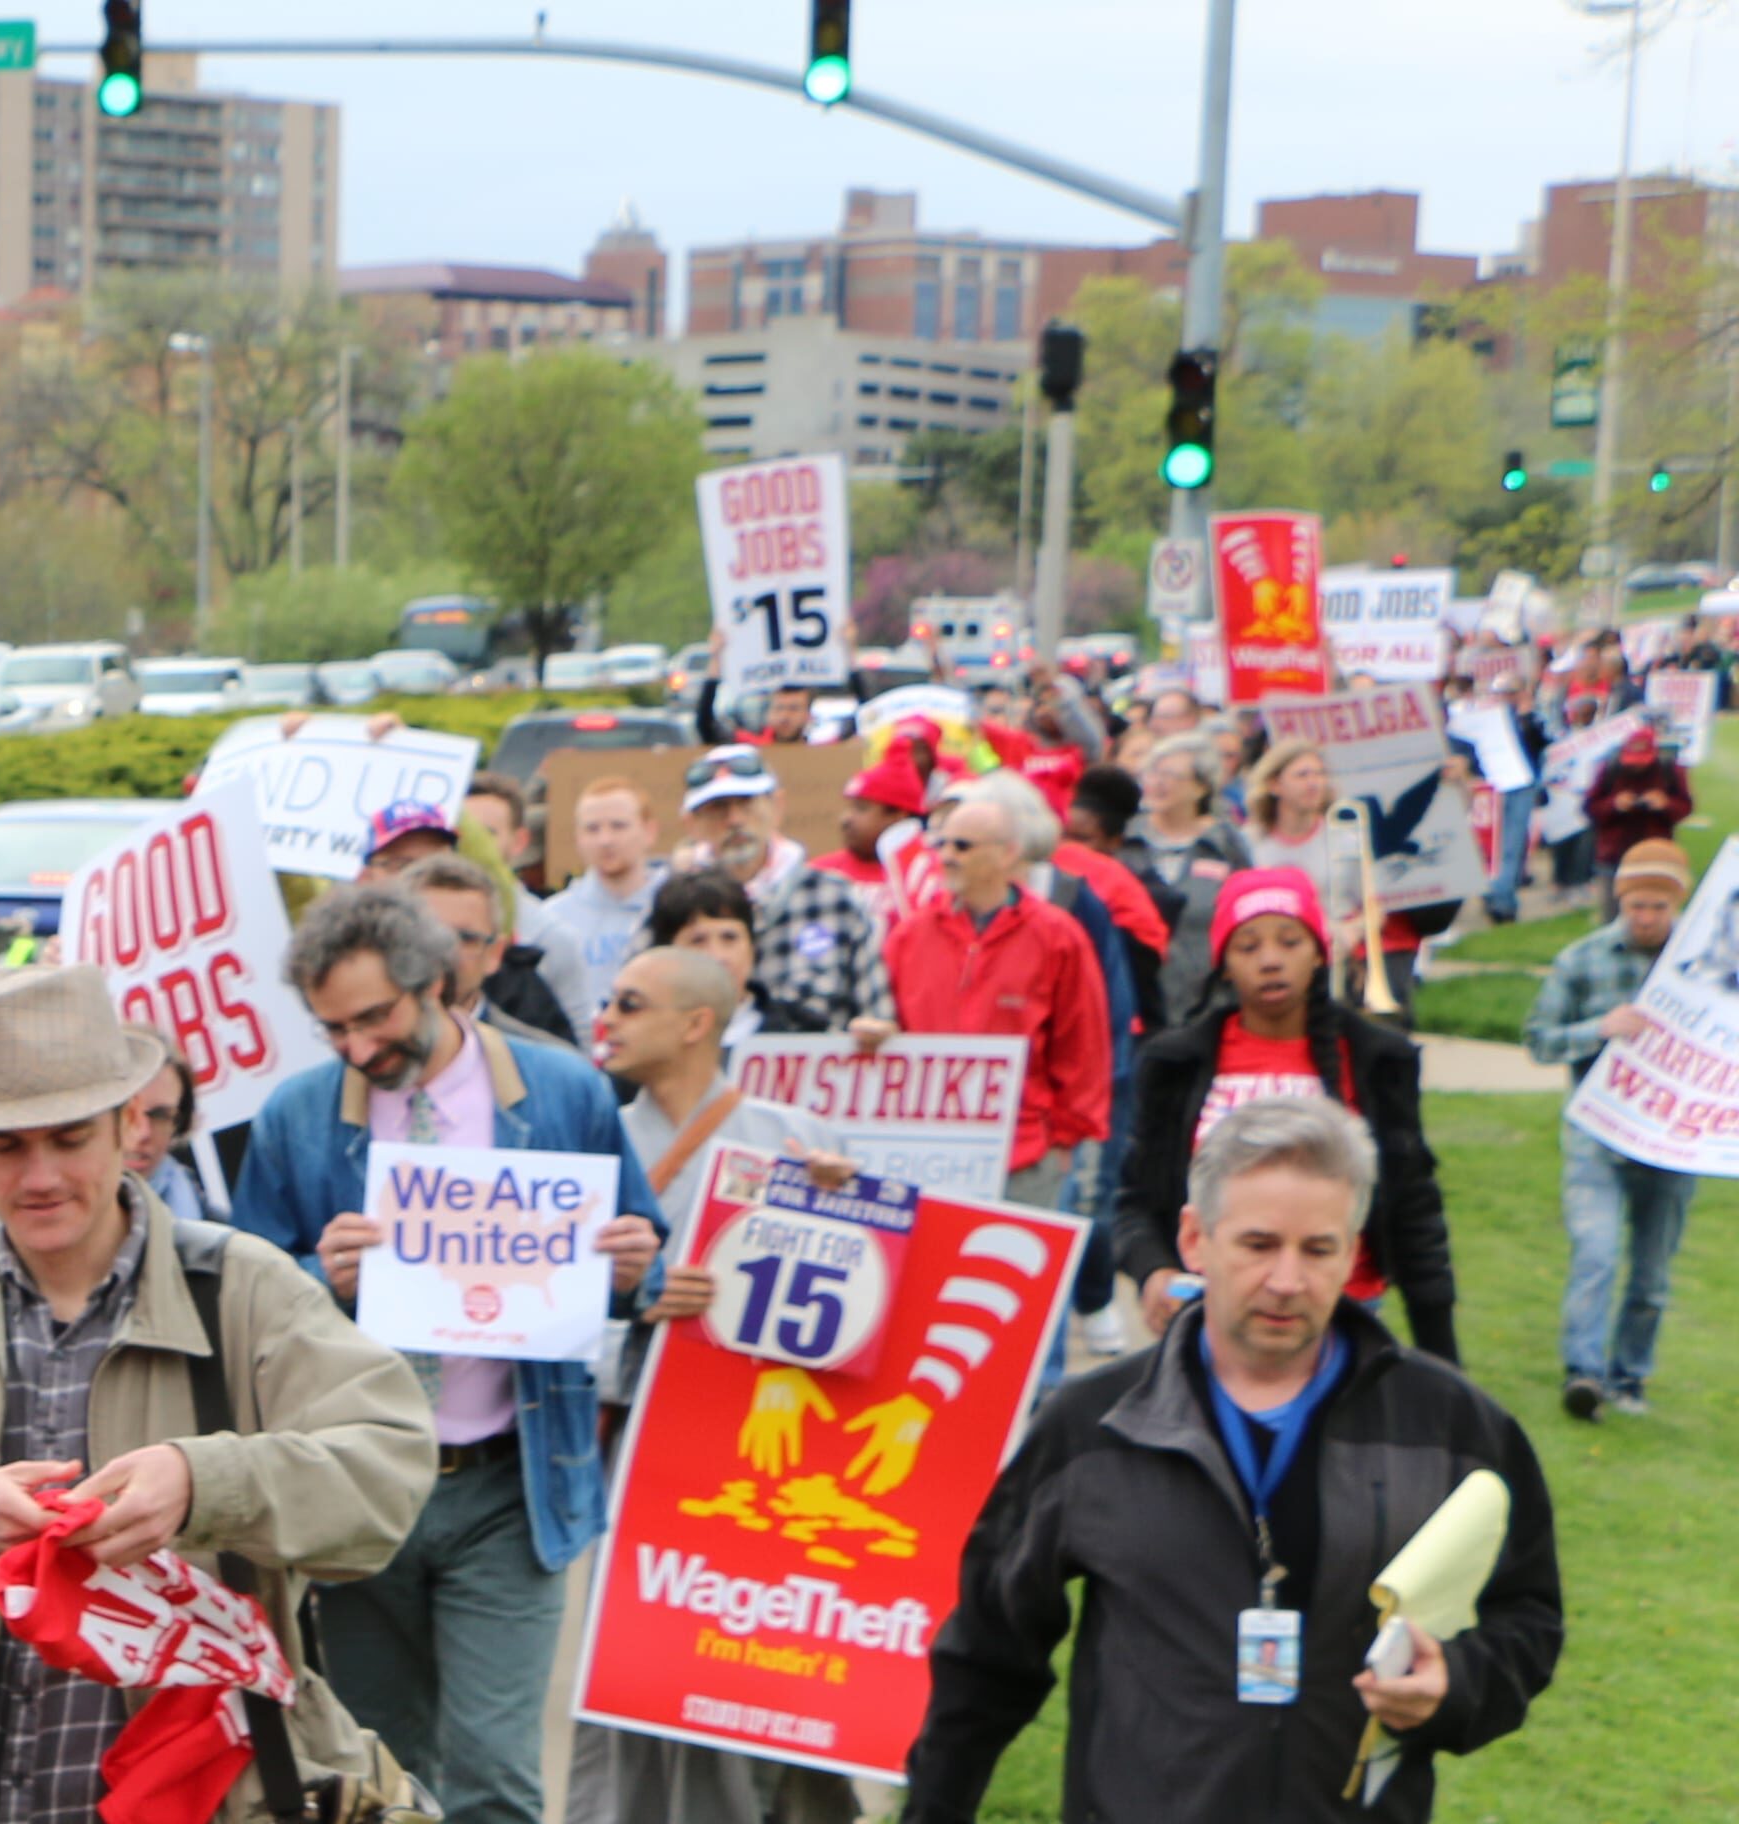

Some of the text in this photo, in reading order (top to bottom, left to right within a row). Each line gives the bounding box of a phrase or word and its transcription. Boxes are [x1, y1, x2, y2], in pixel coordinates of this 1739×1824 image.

[719, 463, 822, 526] GOOD
[728, 521, 828, 581] JOBS
[732, 584, 829, 653] $15
[1270, 688, 1431, 746] HUELGA
[120, 950, 280, 1088] BS
[740, 1054, 1009, 1122] ON STRIKE
[389, 1165, 583, 1212] We Are
[885, 1150, 1003, 1187] RIGHT
[392, 1219, 579, 1265] United
[742, 1214, 866, 1267] FIGHT FOR
[736, 1254, 849, 1359] 15
[636, 1542, 931, 1658] WageTheft
[824, 1654, 848, 1684] it
